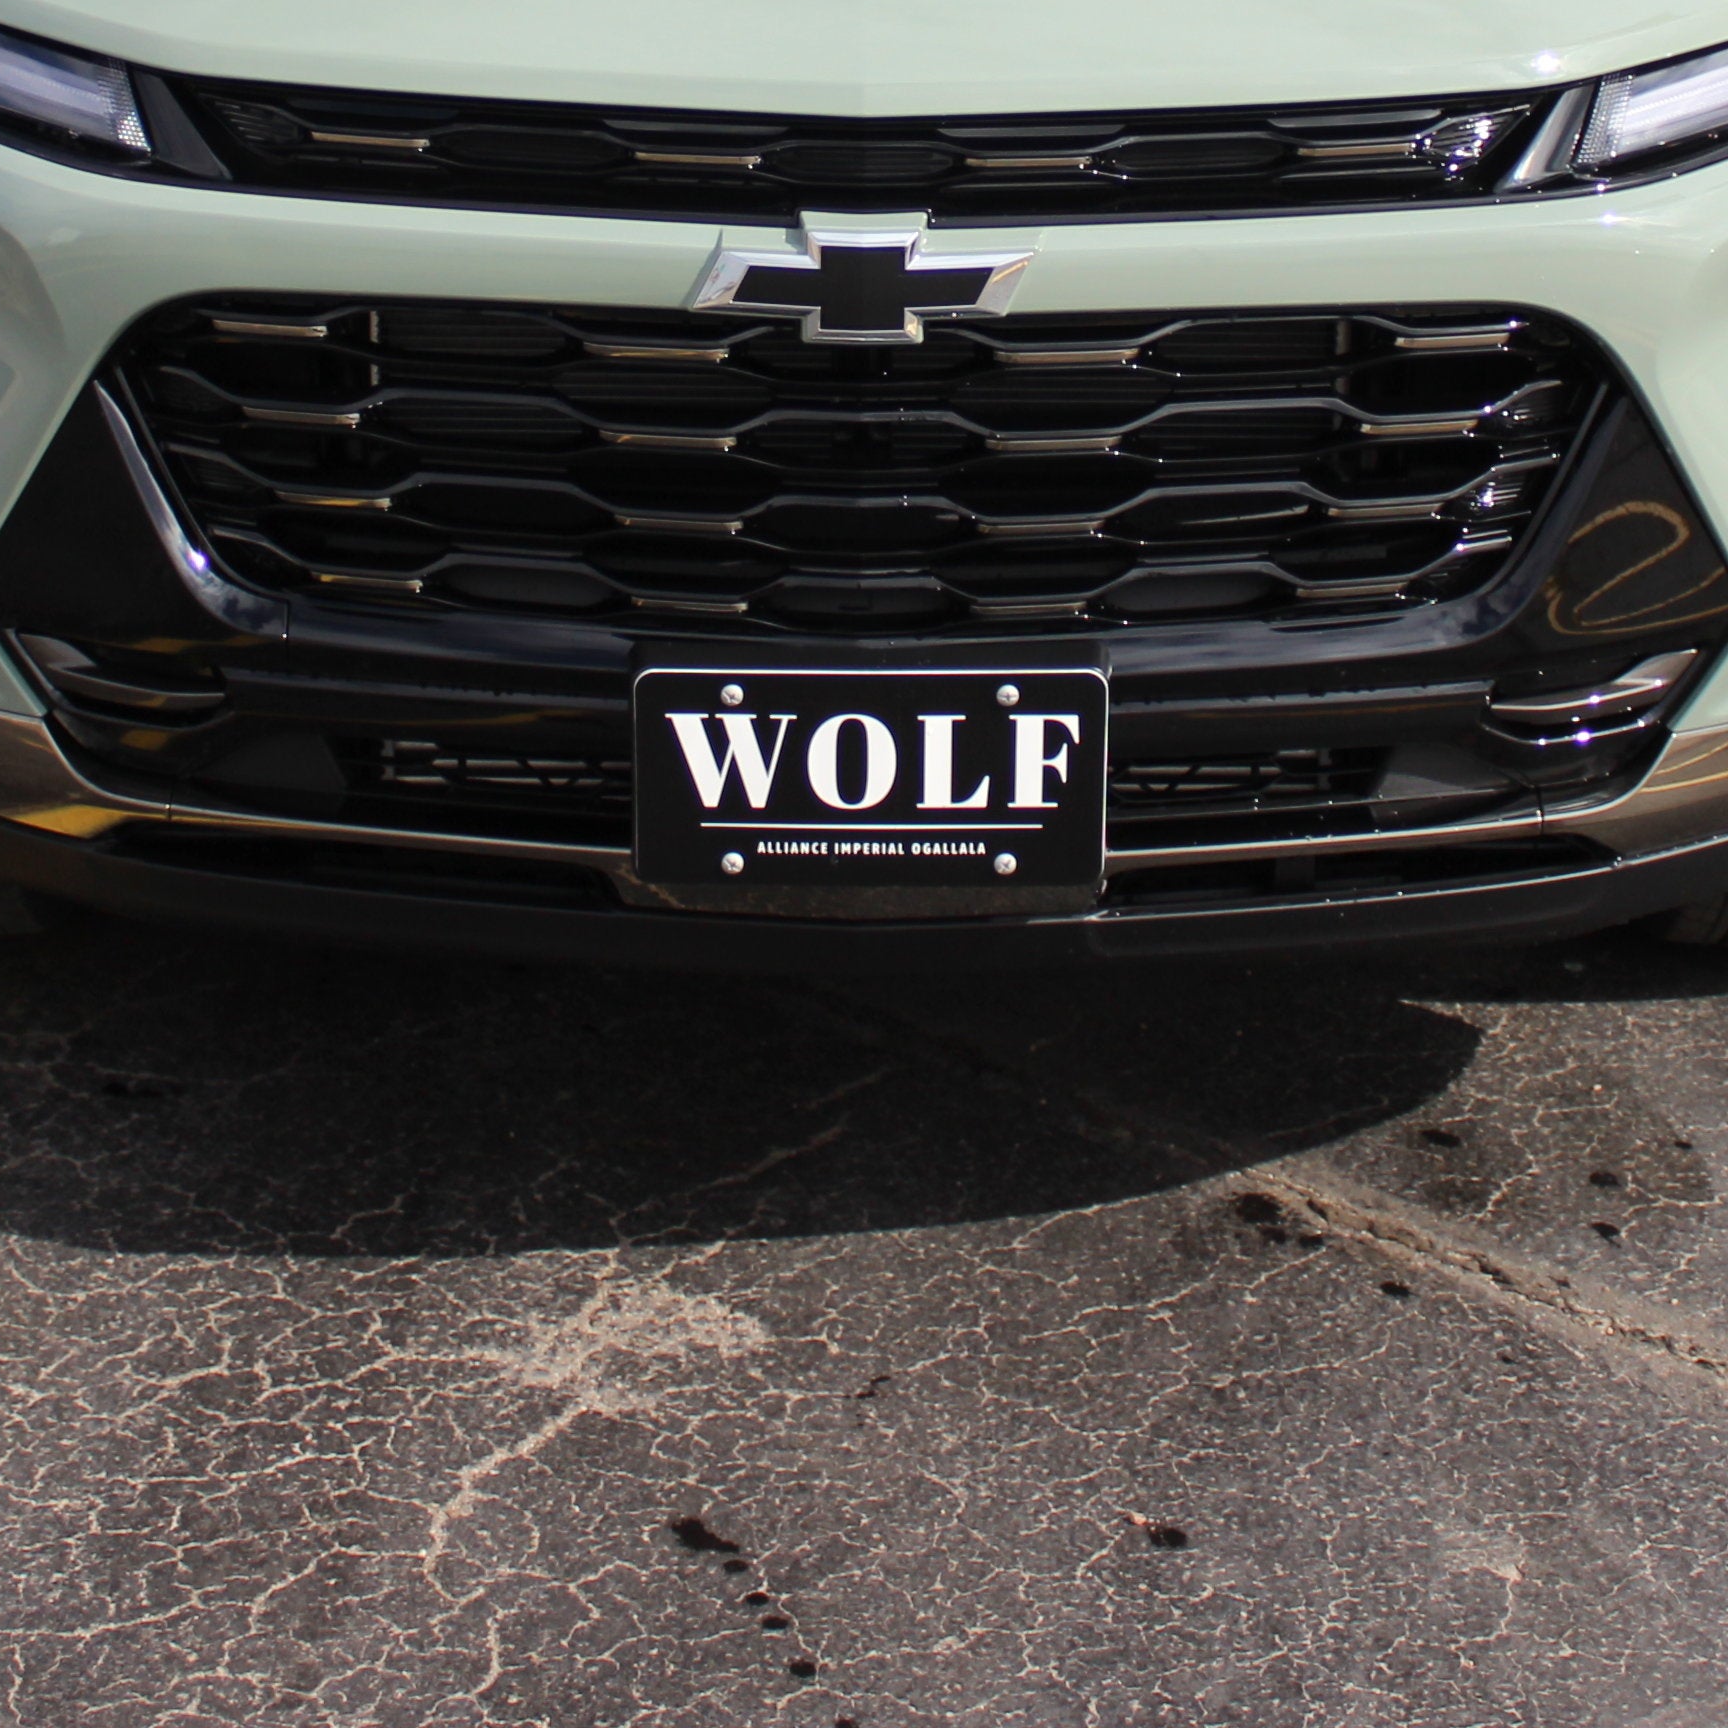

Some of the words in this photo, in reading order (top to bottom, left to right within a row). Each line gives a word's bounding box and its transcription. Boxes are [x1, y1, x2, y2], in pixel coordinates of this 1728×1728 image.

[664, 712, 1080, 810] WOLF
[756, 841, 828, 855] ALLIANCE
[834, 842, 905, 855] IMPERIAL
[910, 842, 986, 856] OGALLALA
